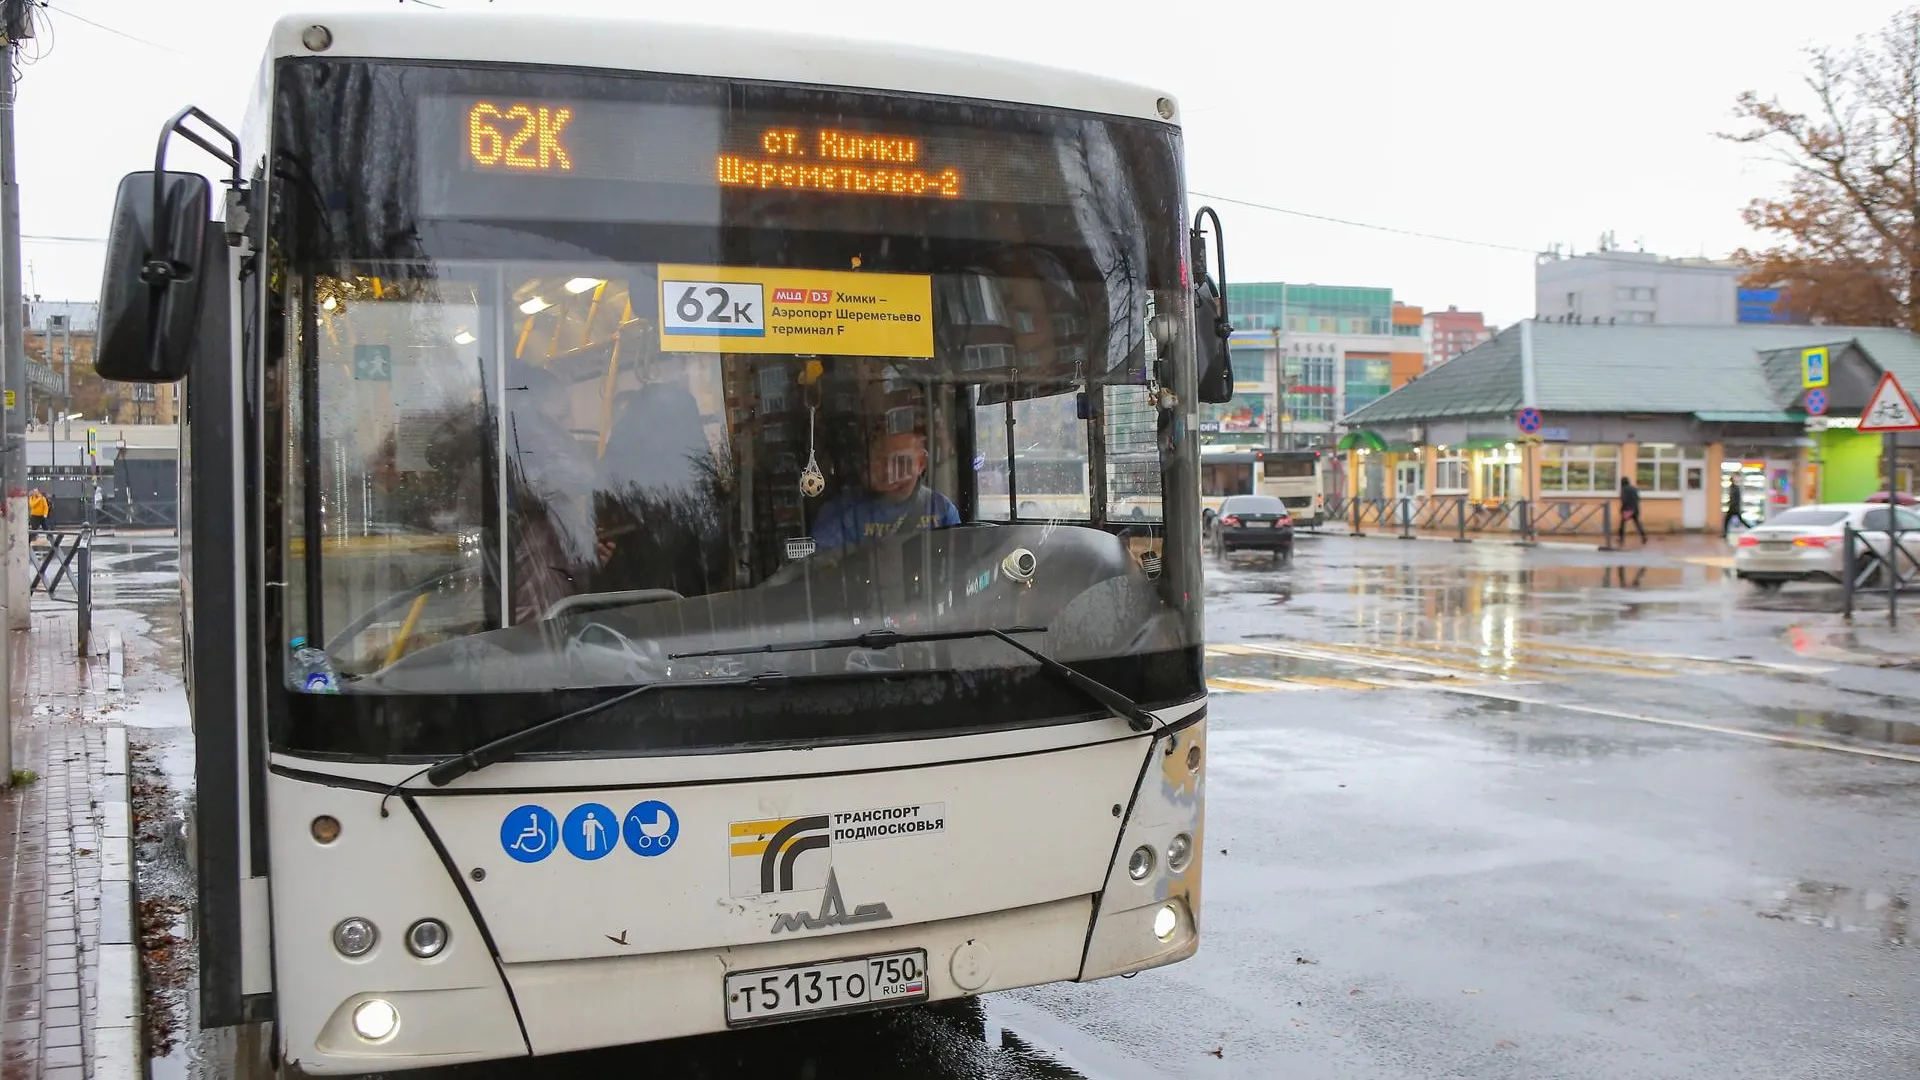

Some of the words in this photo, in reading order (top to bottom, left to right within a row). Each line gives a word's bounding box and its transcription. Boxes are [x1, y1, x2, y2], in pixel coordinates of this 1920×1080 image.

[470, 103, 571, 169] 62К
[764, 131, 805, 156] ст.
[820, 131, 914, 163] Химки
[717, 155, 958, 196] Шереметьево-2
[836, 292, 876, 304] Химки
[771, 306, 833, 321] Аэропорт
[835, 309, 921, 323] Шереметьево
[772, 324, 834, 337] терминал
[837, 325, 845, 335] F
[834, 806, 920, 825] ТРАНСПОРТ
[834, 818, 944, 840] ПОДМОСКОВЬЯ
[870, 957, 916, 986] 750
[883, 984, 905, 995] RUS
